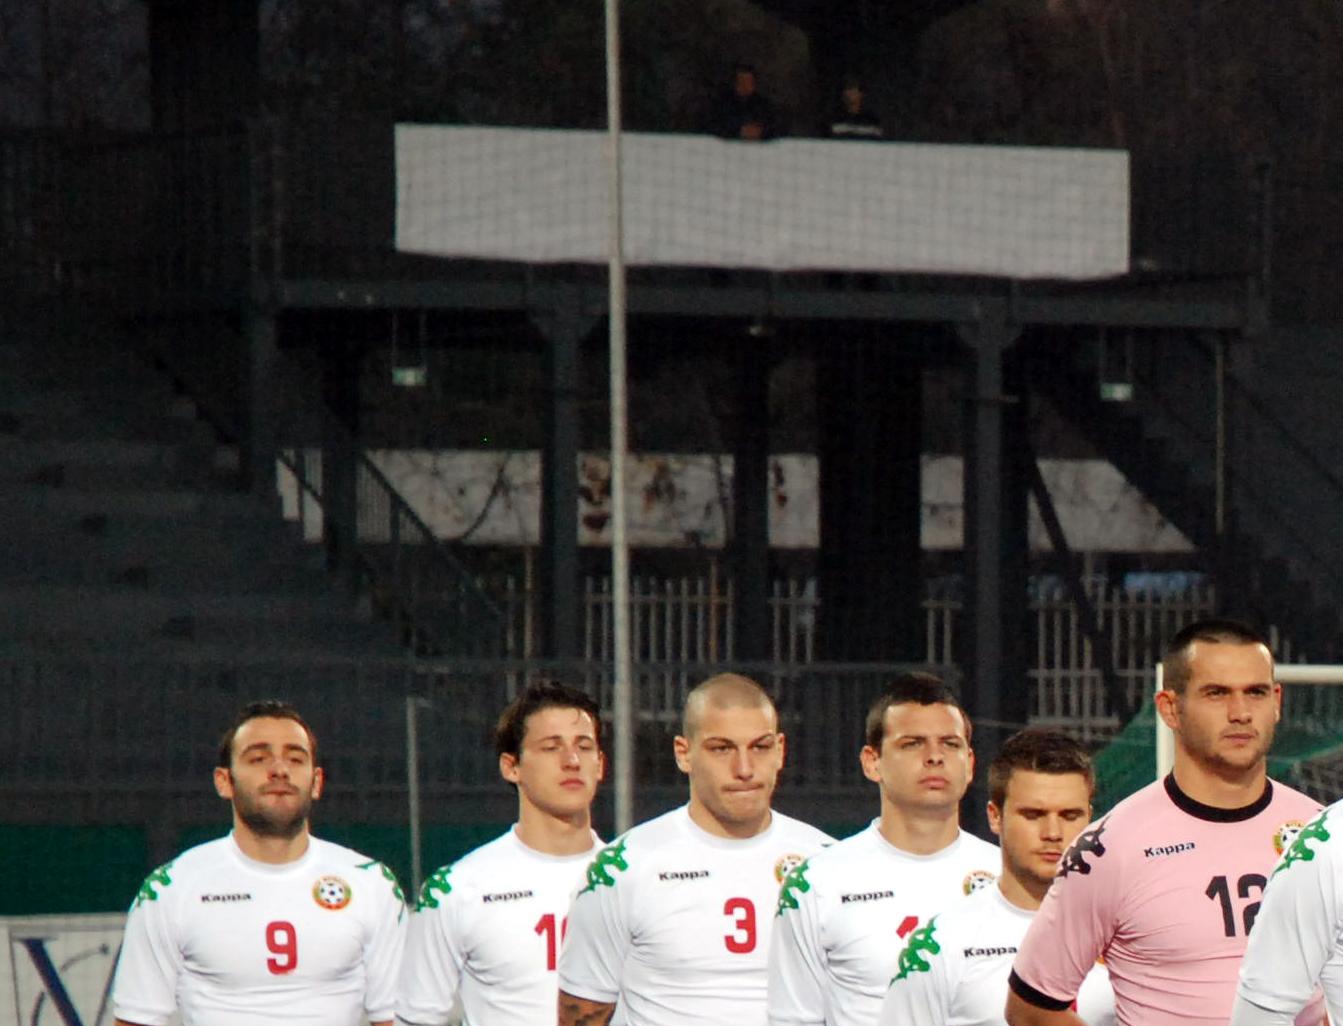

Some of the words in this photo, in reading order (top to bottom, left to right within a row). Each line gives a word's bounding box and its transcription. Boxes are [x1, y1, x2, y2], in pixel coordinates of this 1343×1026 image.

[1143, 842, 1196, 858] Kappa
[658, 870, 710, 882] Kappa
[483, 890, 533, 903] Kappa
[840, 890, 894, 904] Kappa
[1205, 874, 1267, 937] 12
[725, 898, 757, 954] 3
[266, 922, 297, 975] 9
[535, 914, 567, 971] 1
[963, 946, 1018, 959] Kappa
